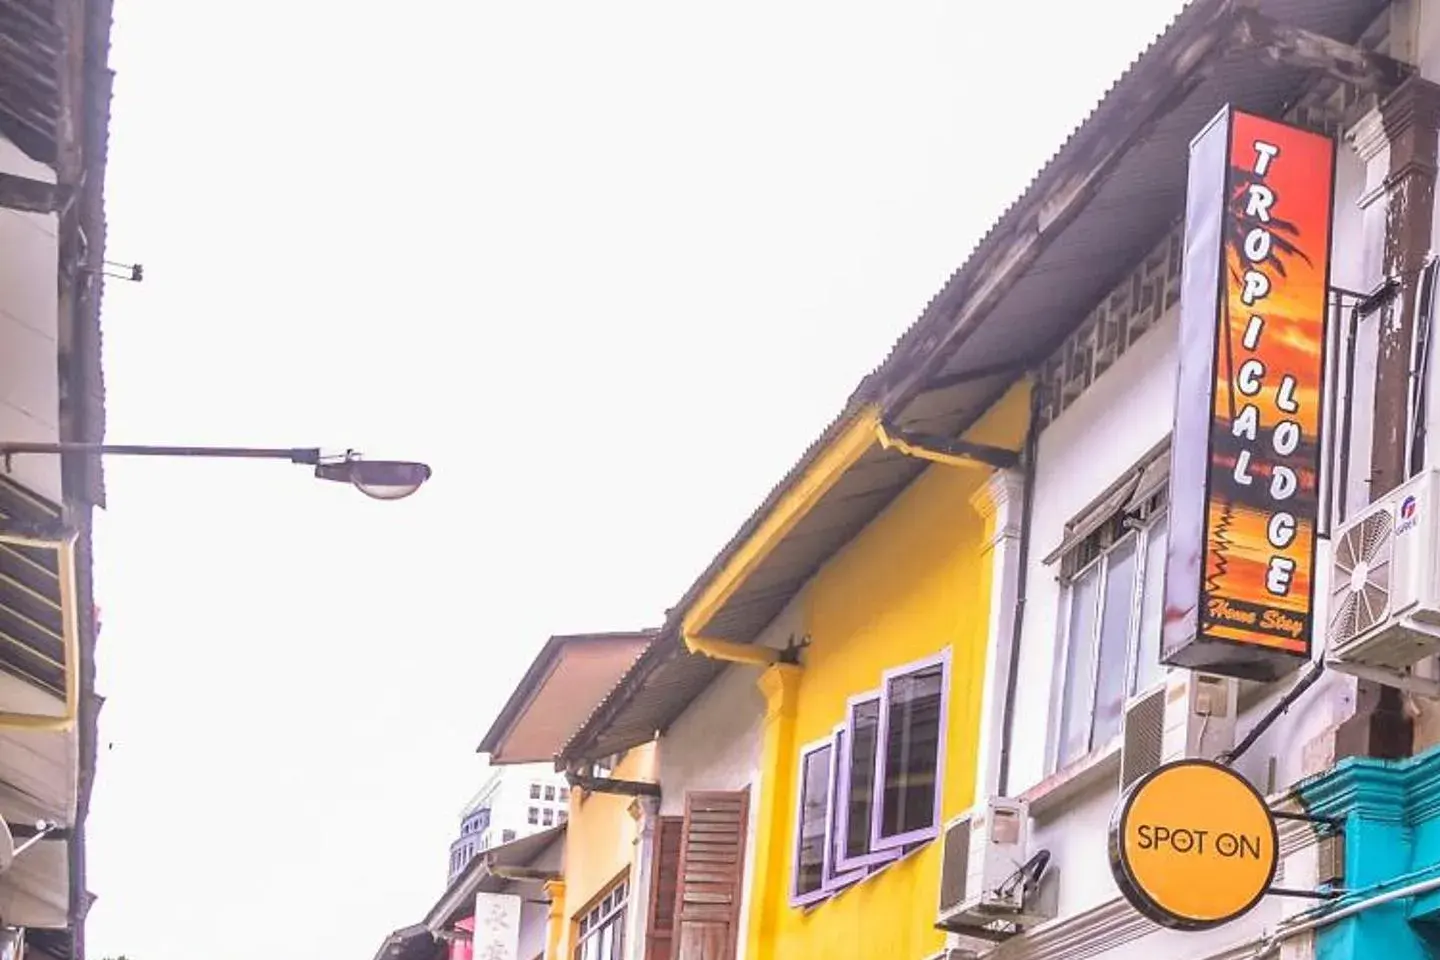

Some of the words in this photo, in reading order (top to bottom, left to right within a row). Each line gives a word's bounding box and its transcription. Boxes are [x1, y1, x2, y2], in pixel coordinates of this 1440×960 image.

[1232, 140, 1280, 485] TROPICAL
[1266, 375, 1300, 595] LODGE
[1260, 609, 1303, 638] Stay
[1137, 824, 1209, 855] SPOT
[1215, 832, 1261, 860] ON
